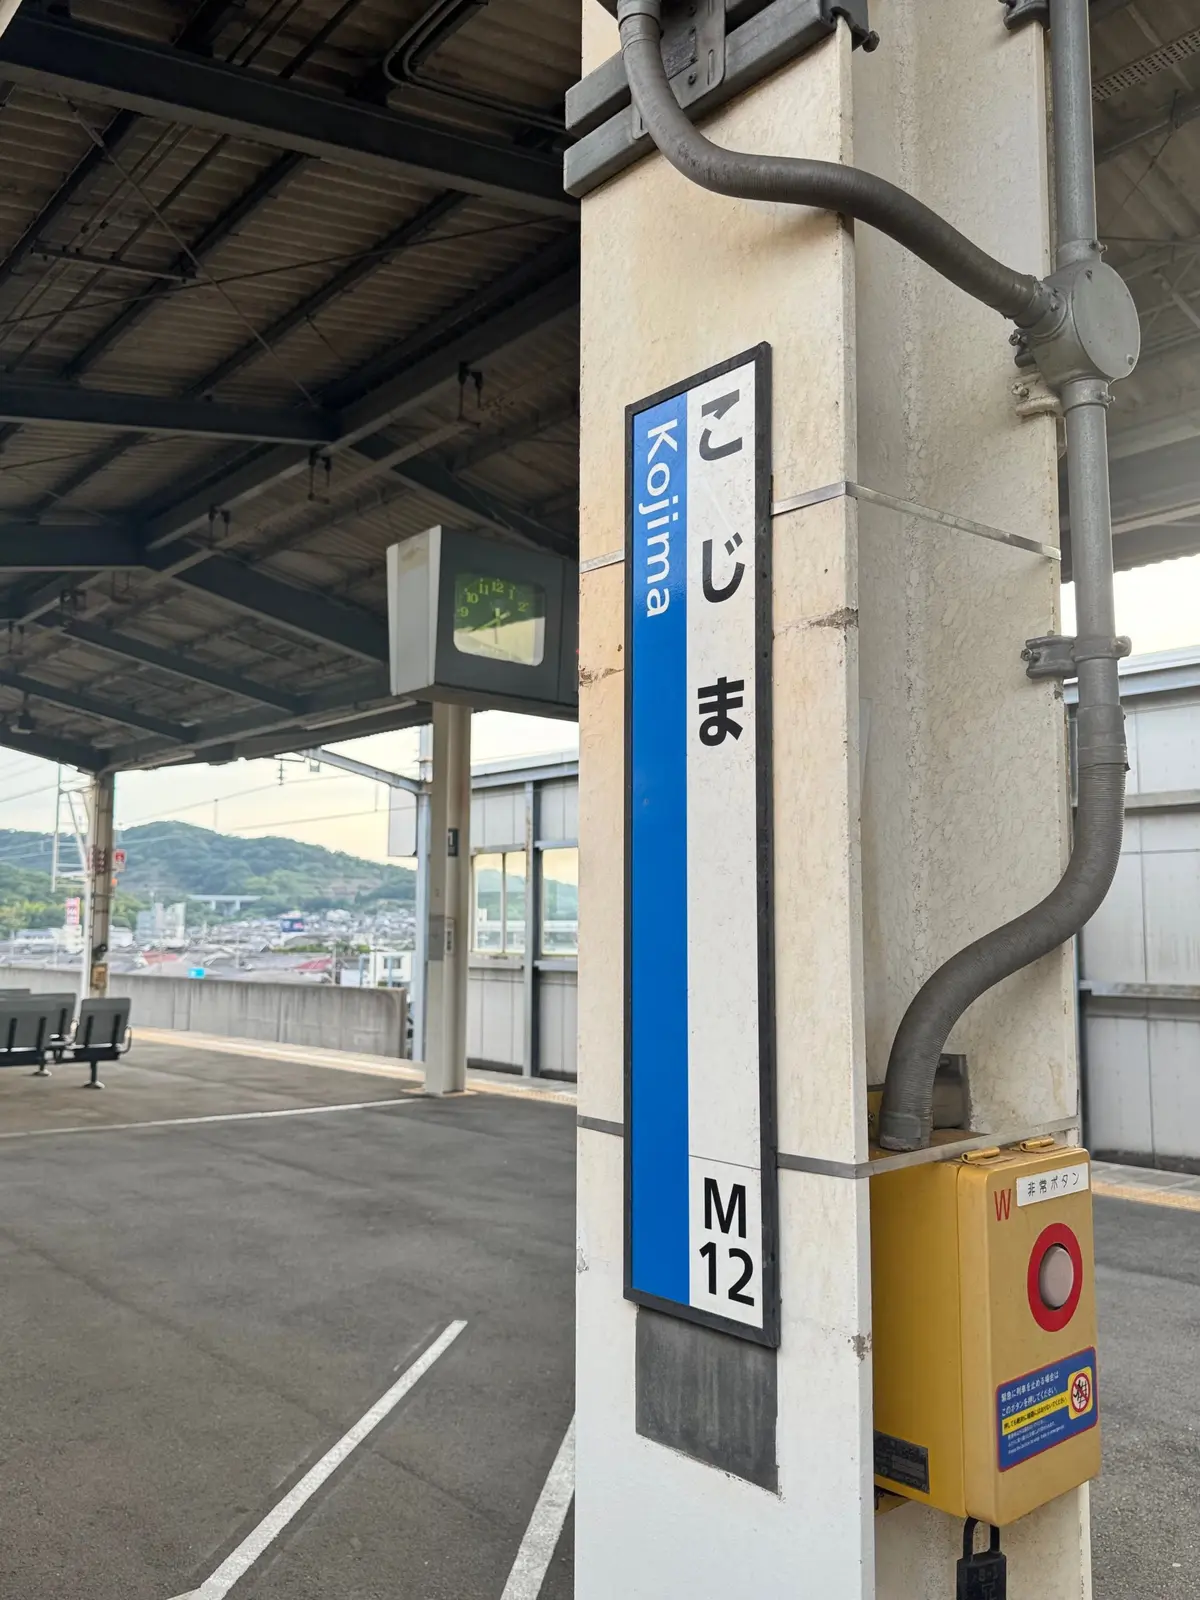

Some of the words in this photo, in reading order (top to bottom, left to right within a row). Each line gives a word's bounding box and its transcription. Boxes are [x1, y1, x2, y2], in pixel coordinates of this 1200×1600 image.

[638, 418, 679, 618] Kojima
[698, 388, 745, 747] こじま
[466, 591, 479, 604] 10
[479, 583, 489, 595] 11
[492, 581, 504, 593] 12
[1027, 1172, 1080, 1197] 非常ボタン
[703, 1177, 747, 1239] M
[993, 1188, 1012, 1222] W
[699, 1241, 755, 1307] 12
